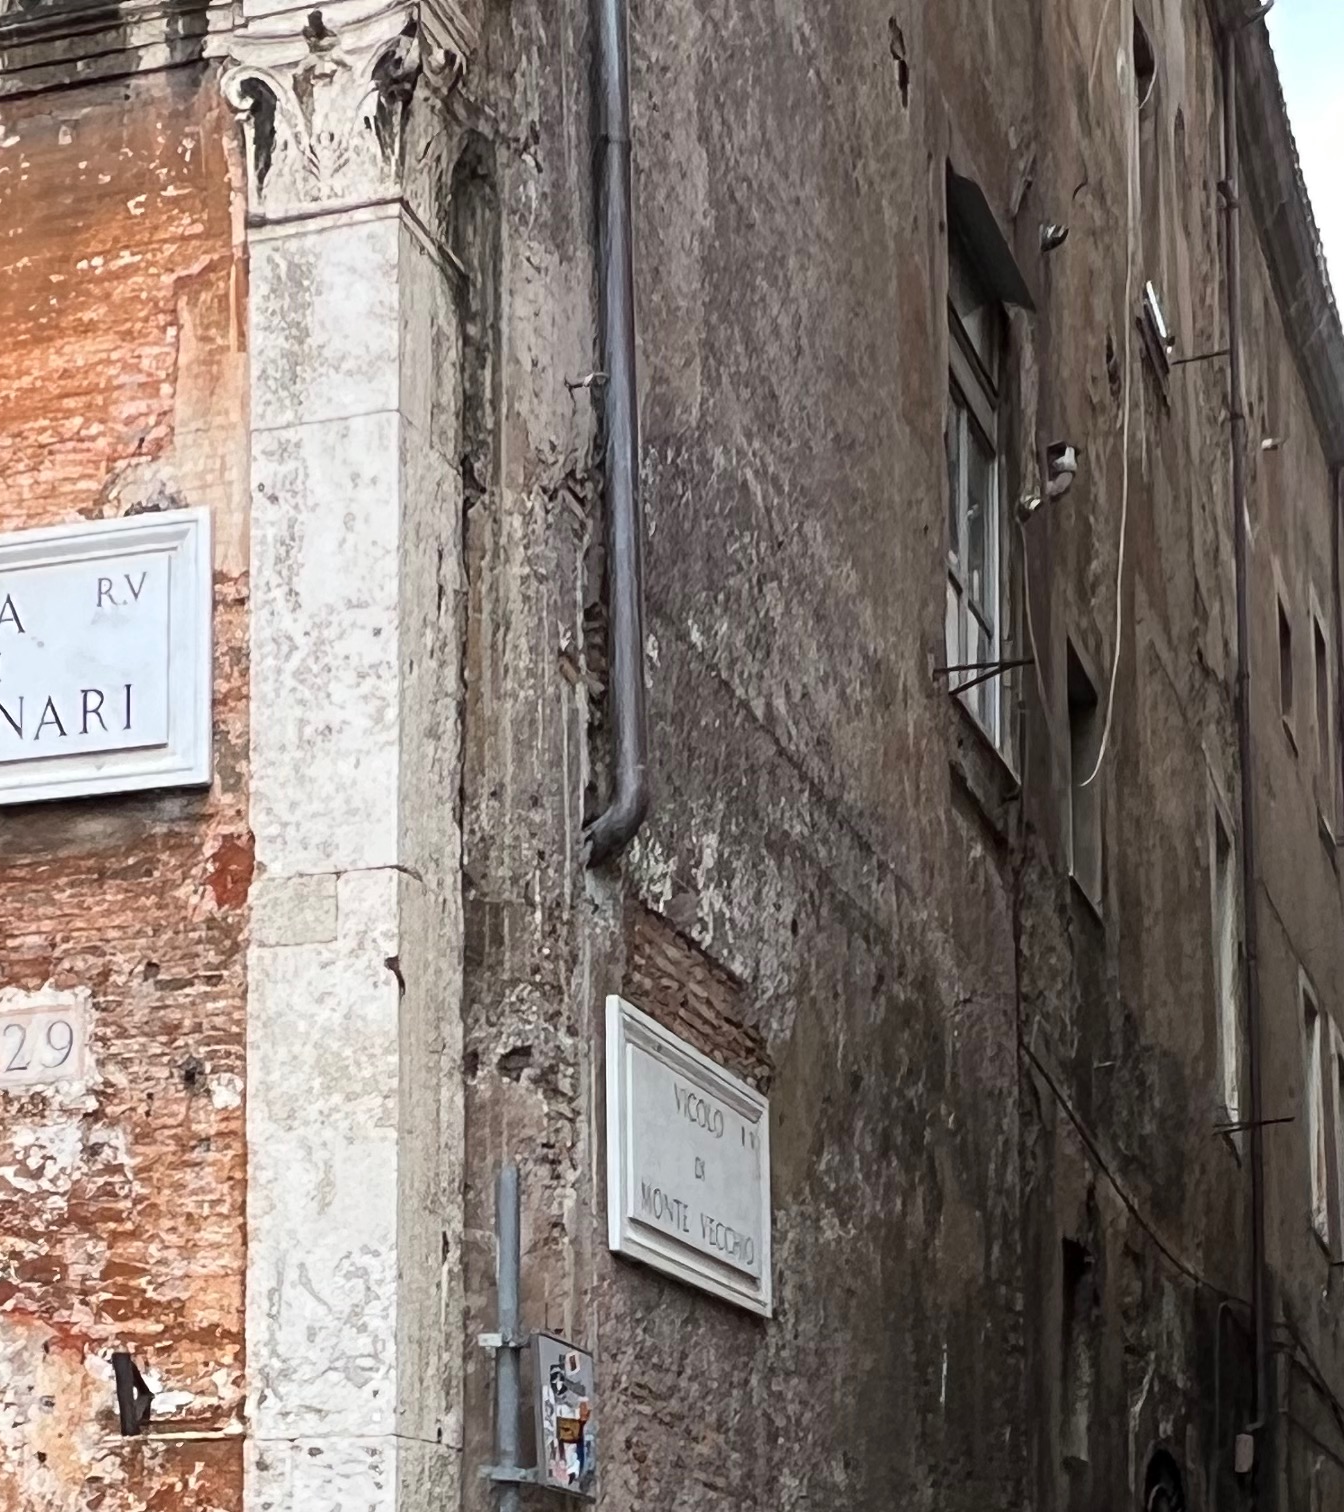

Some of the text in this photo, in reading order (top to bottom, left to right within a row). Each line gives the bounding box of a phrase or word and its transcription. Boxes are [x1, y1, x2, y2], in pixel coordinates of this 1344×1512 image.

[2, 1019, 74, 1074] 29
[674, 1082, 725, 1139] VICOLO
[640, 1177, 755, 1266] MONTE VECCHIO
